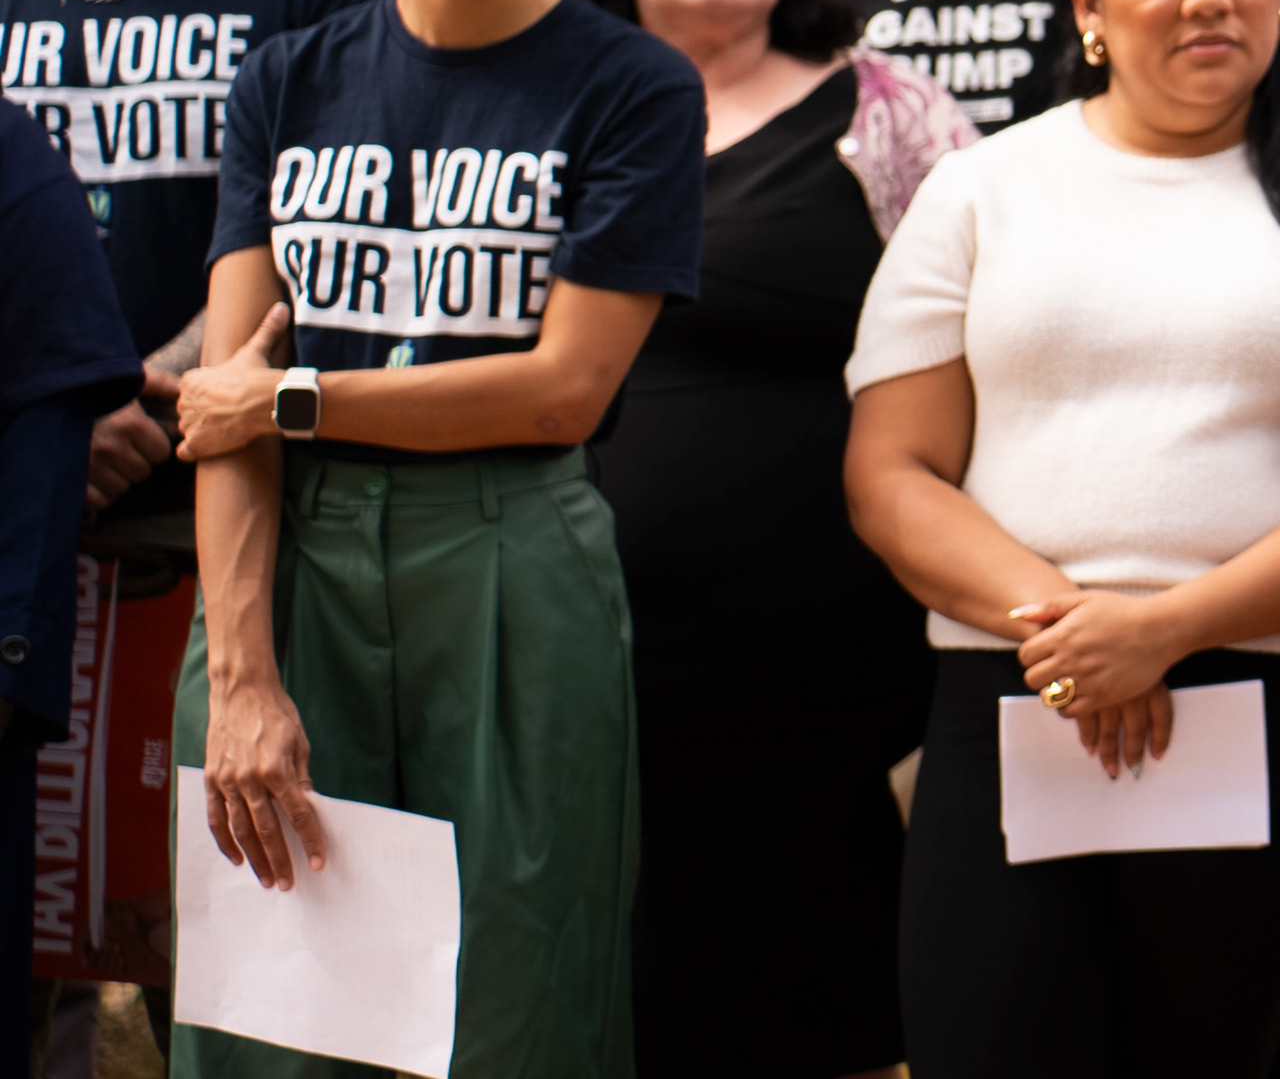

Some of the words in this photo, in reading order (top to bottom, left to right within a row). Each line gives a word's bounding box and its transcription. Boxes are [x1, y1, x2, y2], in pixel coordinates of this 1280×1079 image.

[0, 21, 65, 88] UR
[83, 13, 254, 86] VOICE
[862, 1, 1054, 49] GAINST
[890, 48, 1034, 93] UMP
[92, 95, 226, 164] VOTE
[270, 144, 393, 225] OUR
[411, 147, 569, 231] VOICE
[284, 237, 391, 315] OUR
[414, 243, 551, 319] VOTE
